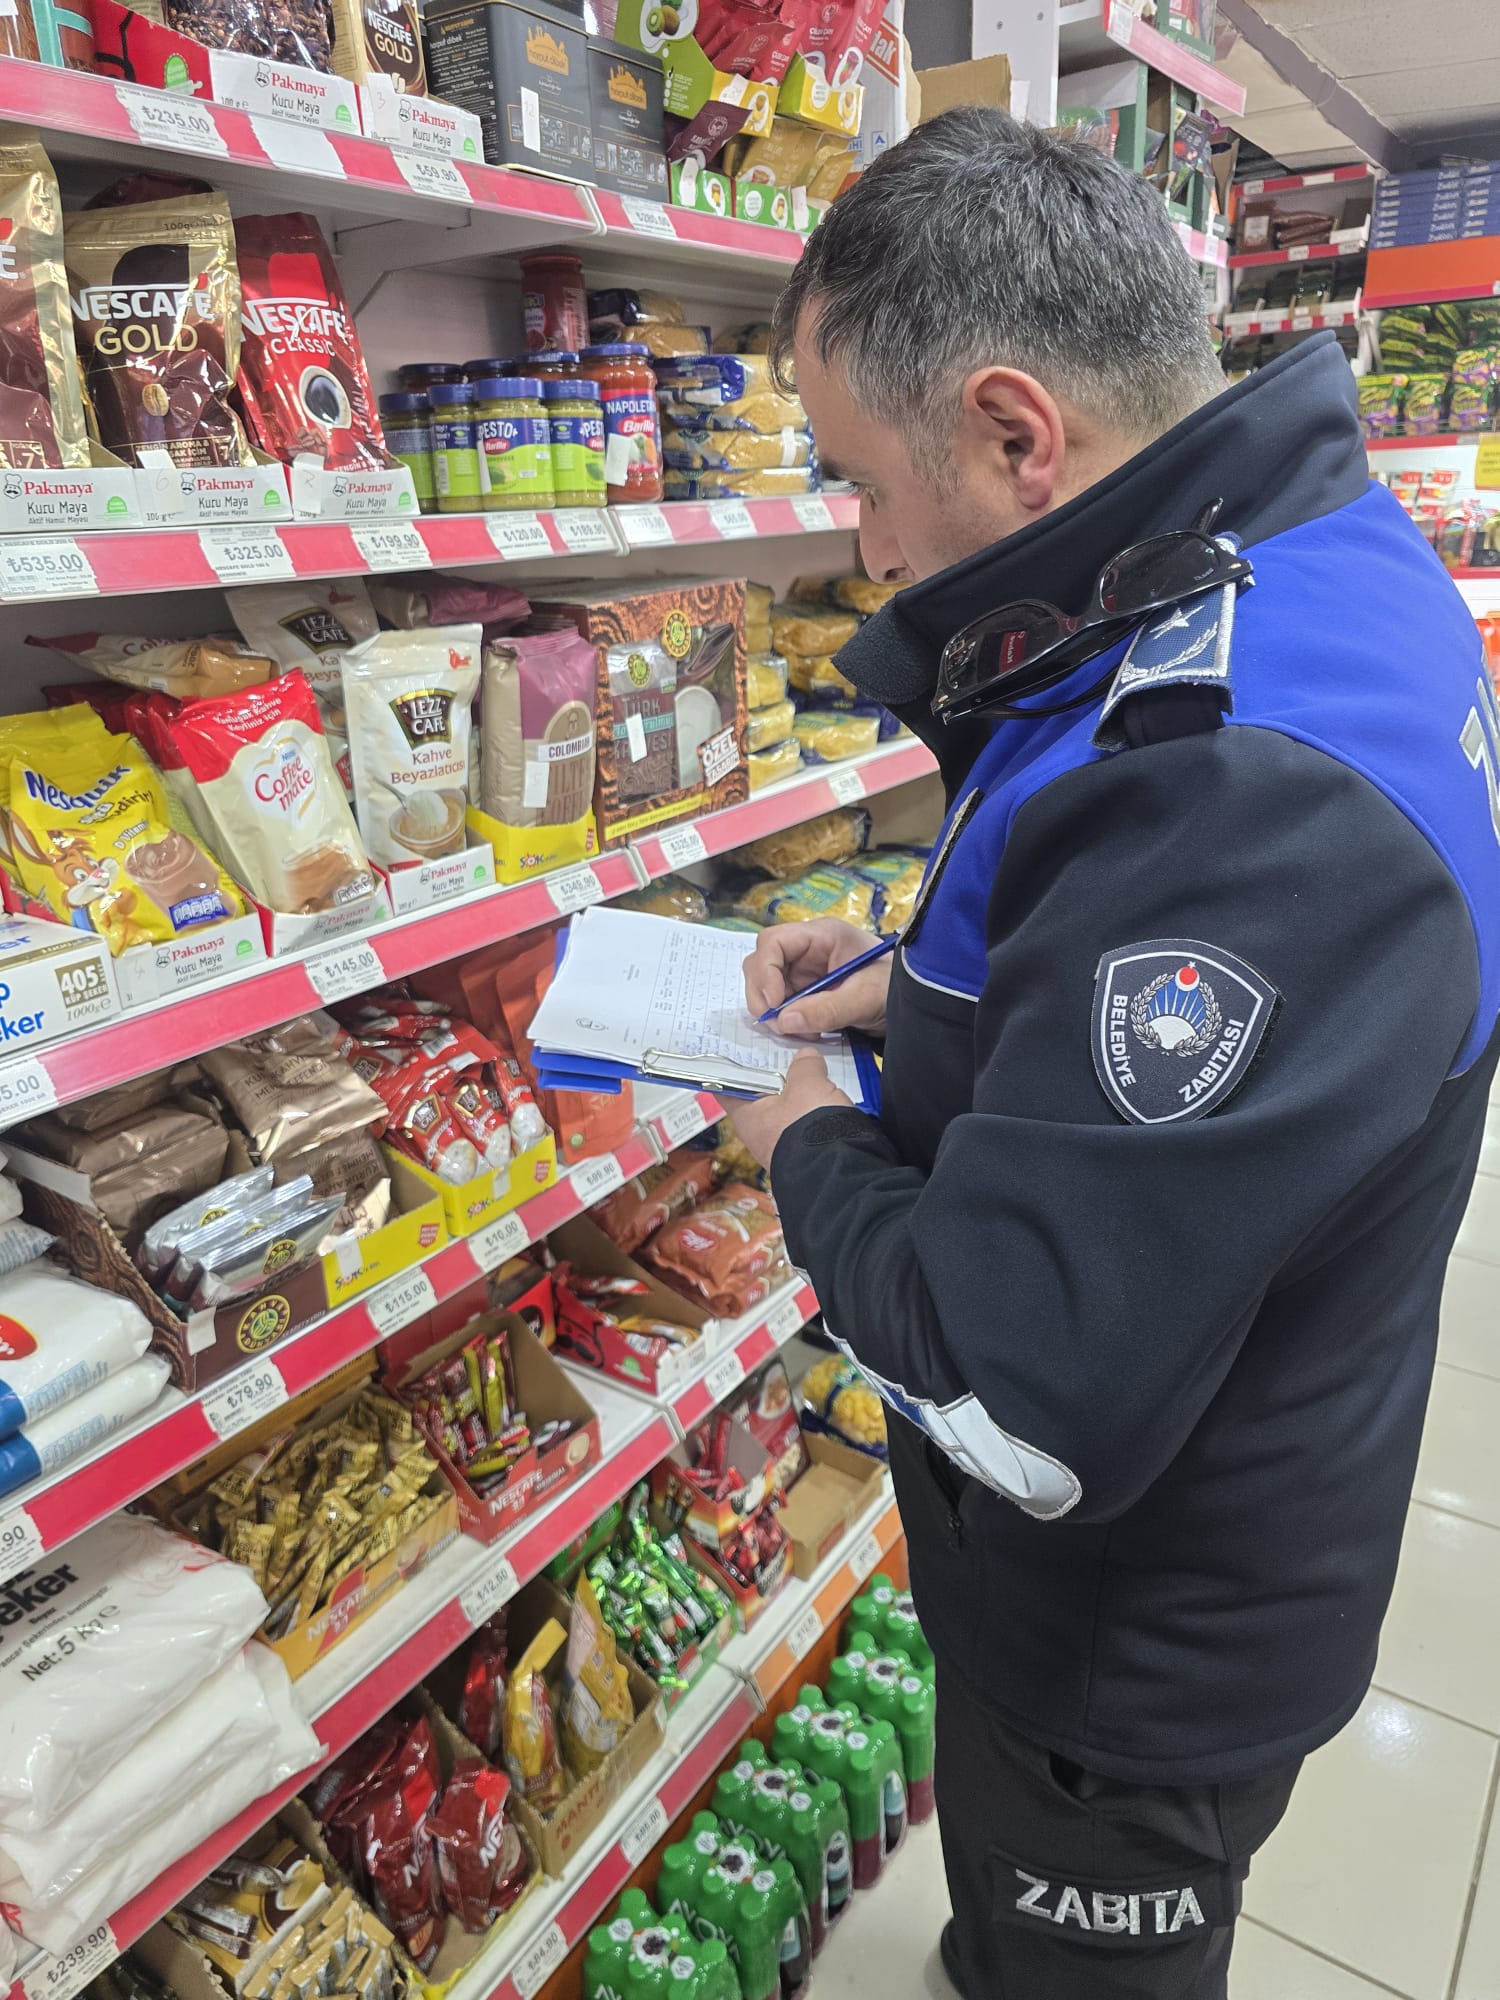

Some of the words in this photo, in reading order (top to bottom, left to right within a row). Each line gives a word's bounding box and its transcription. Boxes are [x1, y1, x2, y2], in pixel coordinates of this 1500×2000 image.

[374, 33, 413, 64] GOLD
[271, 72, 326, 99] Pakmaya
[271, 93, 294, 111] Kuru
[297, 98, 321, 117] Maya
[141, 104, 211, 134] ₺235.00
[412, 109, 456, 132] Pakmaya
[412, 128, 431, 142] Kuru
[433, 131, 451, 149] Maya
[415, 162, 458, 183] ₺59.90
[95, 323, 198, 356] GOLD
[270, 337, 337, 358] CLASSIC
[478, 418, 513, 440] PESTO
[170, 440, 201, 450] AROMA
[24, 481, 93, 498] Pakmaya
[197, 478, 255, 493] Pakmaya
[347, 482, 393, 496] Pakmaya
[27, 502, 55, 515] Kuru
[60, 501, 88, 517] Maya
[199, 497, 222, 509] Kuru
[225, 496, 249, 510] Maya
[346, 499, 366, 509] Kuru
[367, 498, 387, 510] Maya
[371, 533, 420, 549] ₺199.90
[503, 527, 544, 543] ₺120.00
[6, 553, 84, 574] ₺535.00
[223, 544, 284, 561] ₺325.00
[410, 698, 442, 718] LEZZ
[412, 748, 453, 765] Kahve
[24, 764, 132, 811] Nesquik
[254, 756, 304, 803] Coffee
[279, 767, 314, 812] mate
[430, 861, 468, 881] Pakmaya
[431, 882, 448, 893] Kuru
[448, 876, 465, 888] Maya
[172, 936, 226, 962] Pakmaya
[175, 963, 198, 977] Kuru
[200, 952, 223, 971] Maya
[325, 950, 376, 979] ₺145.00
[60, 964, 99, 992] 405
[0, 1010, 45, 1042] ker
[1110, 994, 1137, 1088] BELEDİYE
[1177, 1018, 1245, 1103] ZABITASI
[0, 1074, 41, 1100] 5.00
[486, 1221, 518, 1247] ₺10.00
[385, 1280, 428, 1313] ₺115.00
[227, 1373, 274, 1410] ₺79.90
[0, 1525, 26, 1551] .90
[0, 1563, 80, 1626] eker
[0, 1646, 23, 1668] ancar
[21, 1651, 63, 1682] Net:
[57, 1634, 76, 1656] 5
[1015, 1868, 1206, 1936] ZABITA
[46, 1924, 109, 1984] ₺239.90
